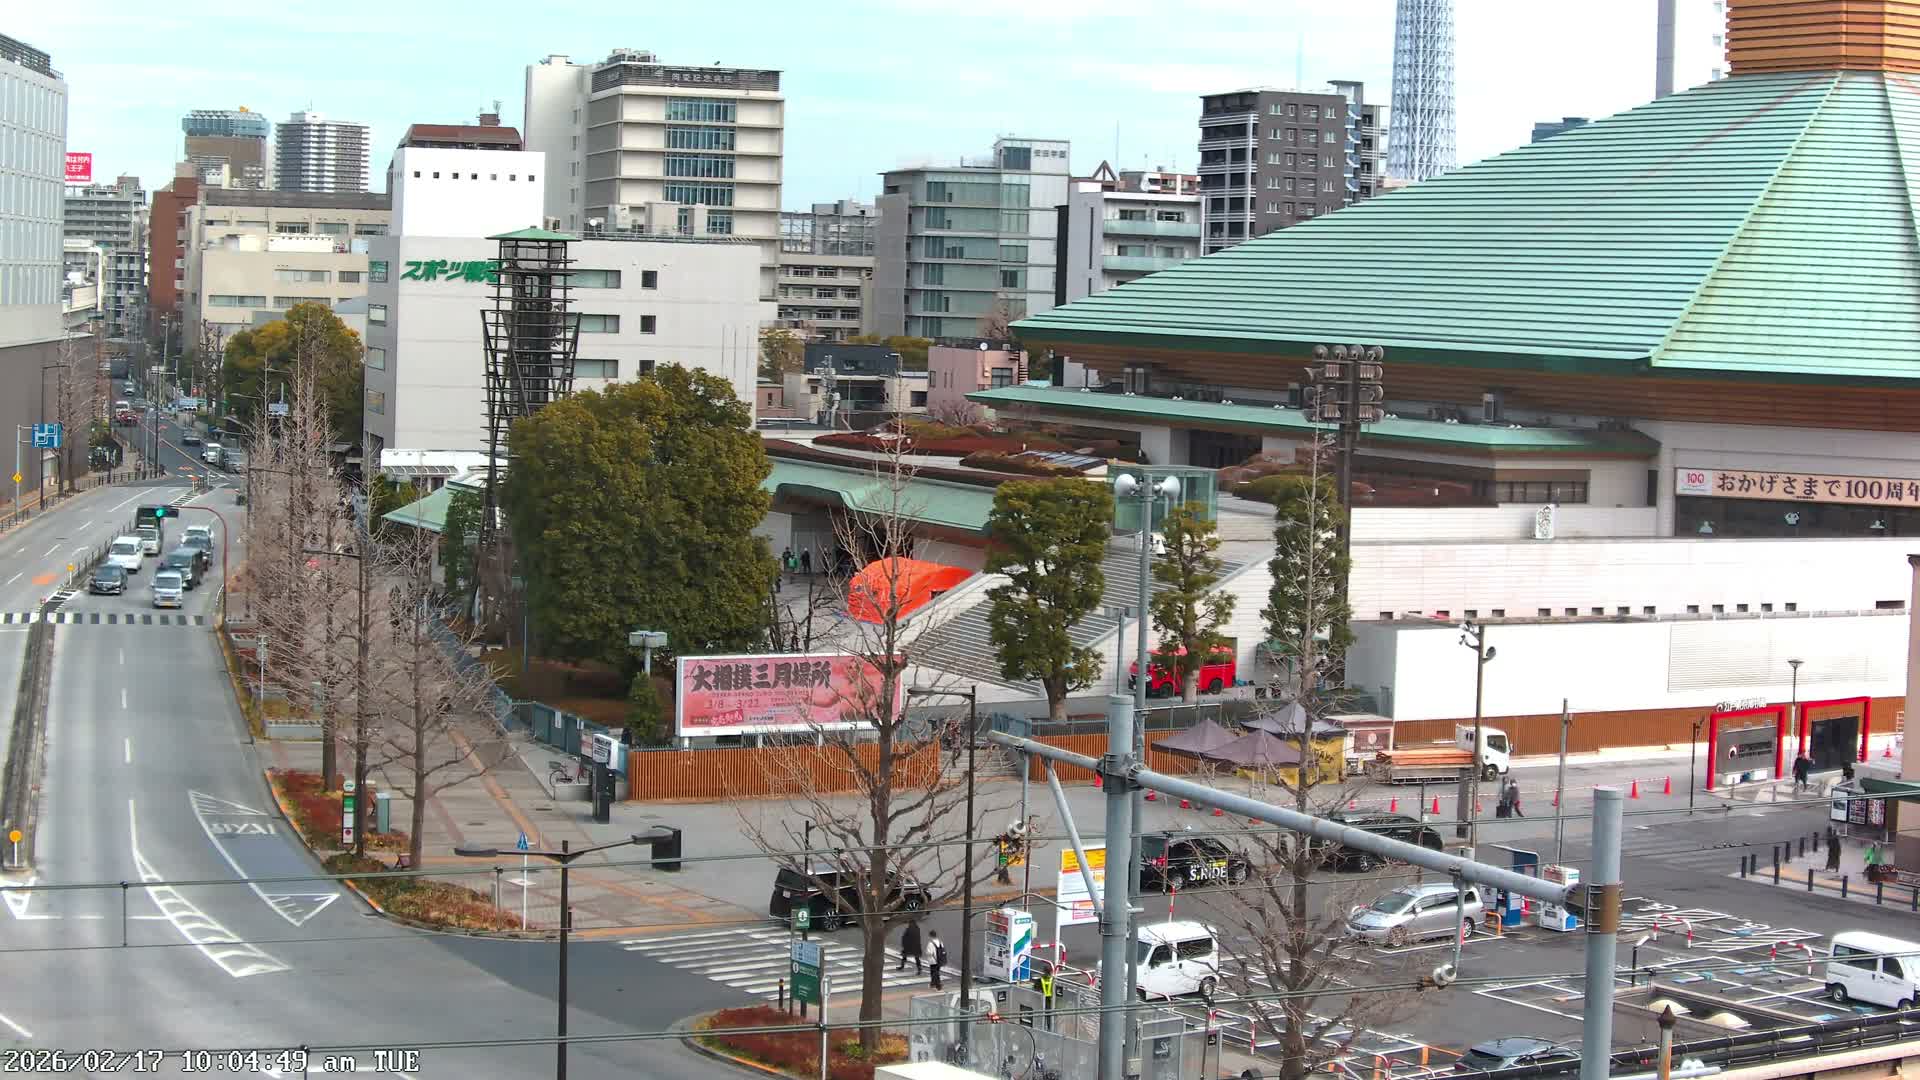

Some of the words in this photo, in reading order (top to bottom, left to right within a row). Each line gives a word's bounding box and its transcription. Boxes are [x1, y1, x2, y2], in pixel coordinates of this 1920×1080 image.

[692, 661, 832, 692] 大相撲三月場所
